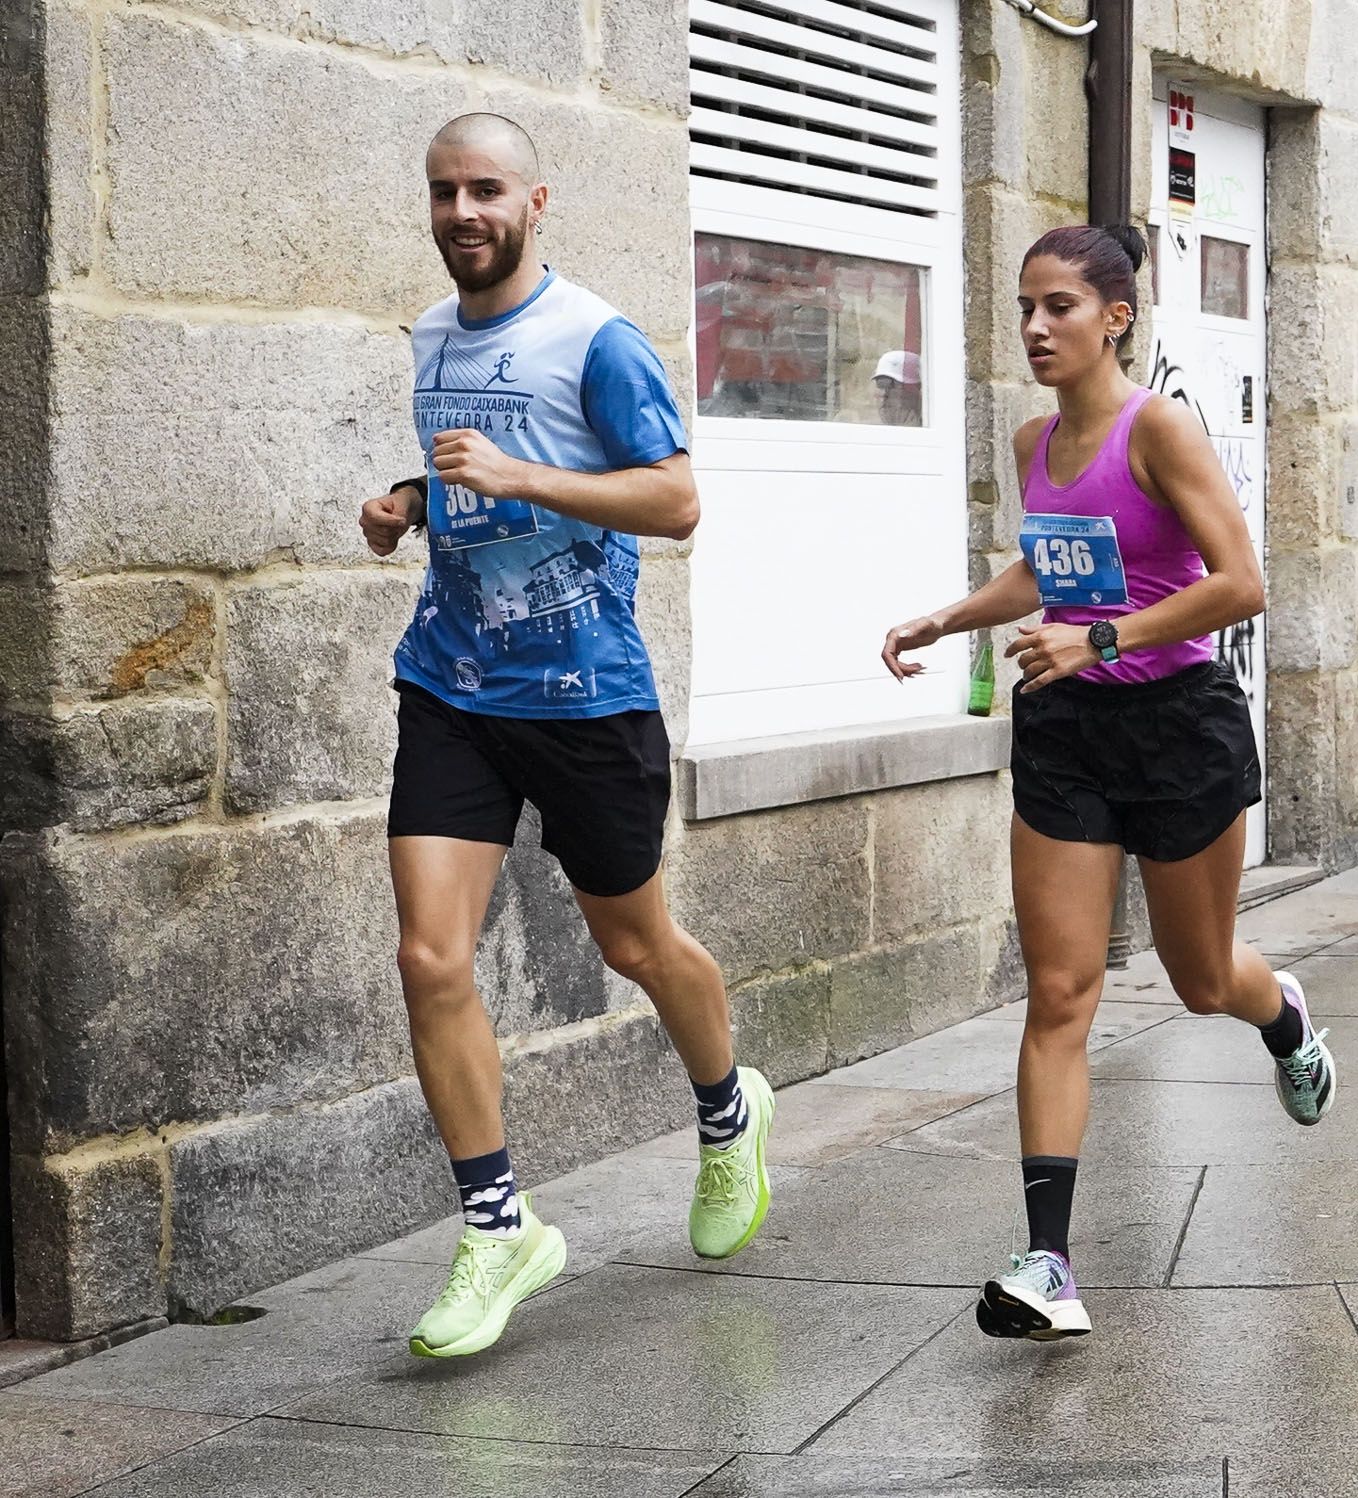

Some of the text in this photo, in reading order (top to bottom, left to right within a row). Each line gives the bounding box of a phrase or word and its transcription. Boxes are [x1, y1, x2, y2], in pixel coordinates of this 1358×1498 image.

[421, 396, 441, 410] GRAN
[443, 396, 472, 410] FONDO
[471, 397, 530, 415] CAIXABANK
[416, 411, 528, 432] ONTEVEDRA 24
[1034, 538, 1095, 576] 436
